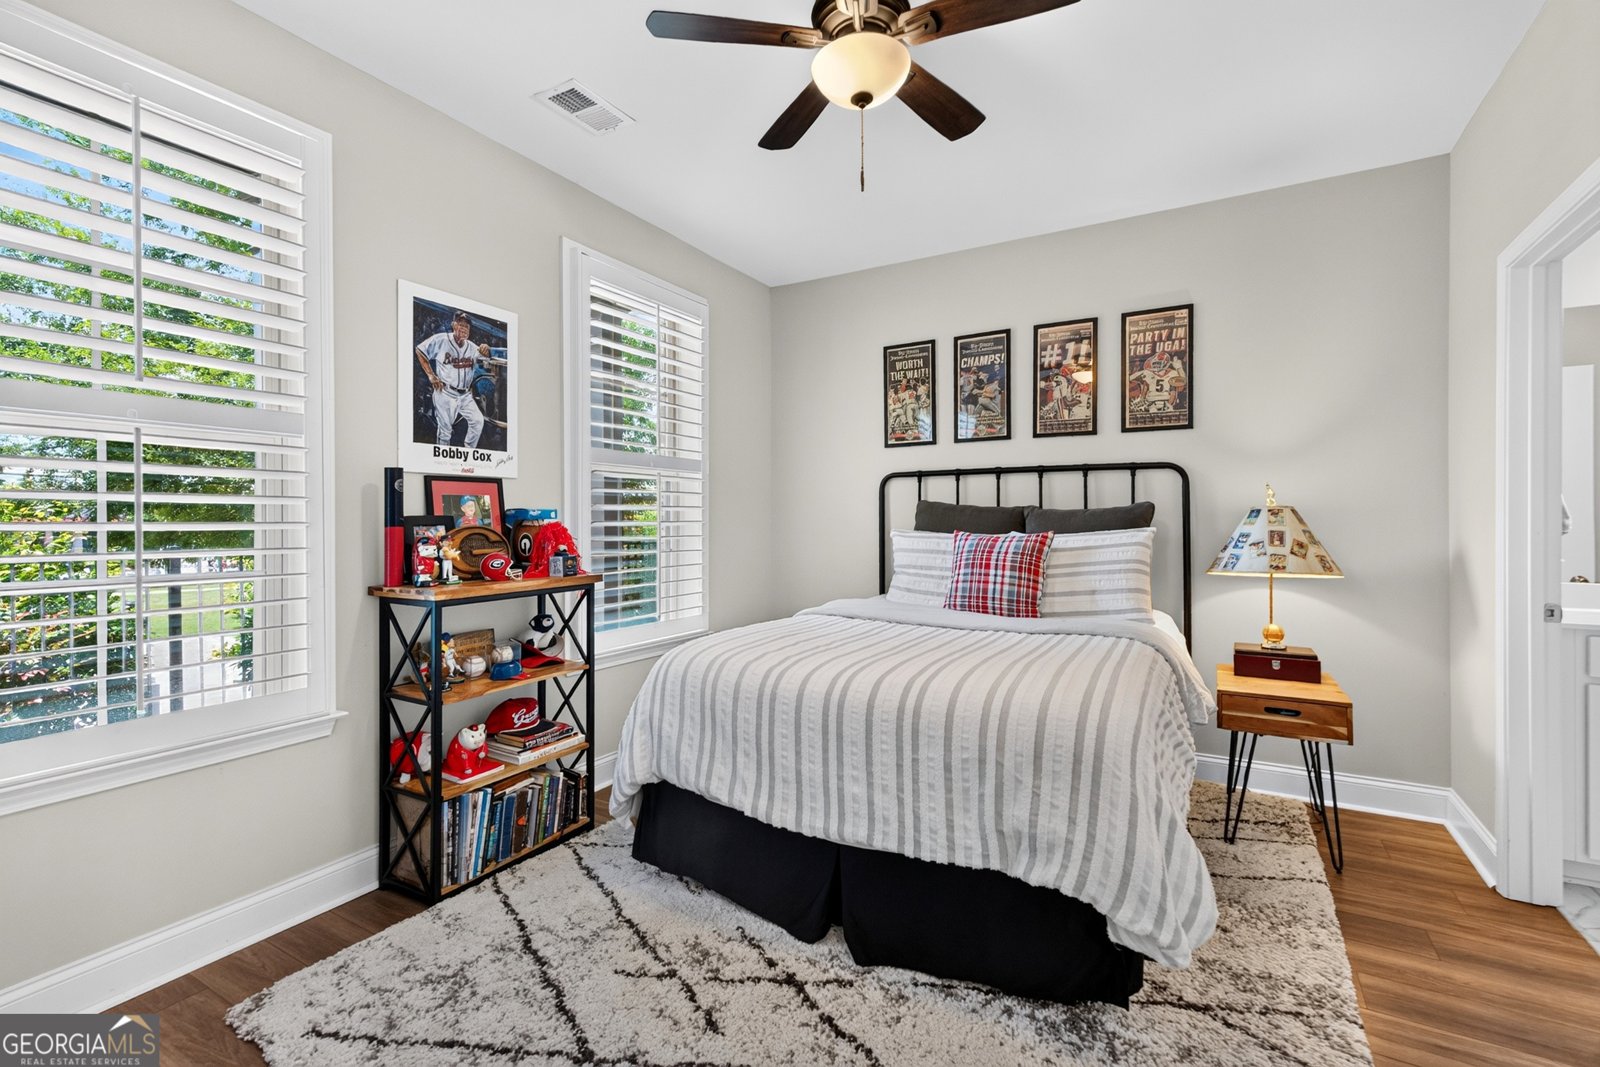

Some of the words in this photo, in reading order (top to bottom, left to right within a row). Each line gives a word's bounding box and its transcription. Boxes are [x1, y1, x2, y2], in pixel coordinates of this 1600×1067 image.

[1130, 328, 1169, 344] PARTY
[1172, 327, 1186, 338] IN
[1129, 343, 1153, 356] THE
[1155, 339, 1187, 353] UGA!
[896, 358, 923, 371] WORTH
[961, 353, 1004, 368] CHAMPS!
[890, 370, 905, 381] THE
[905, 367, 929, 379] WAIT!
[1155, 379, 1164, 393] 5
[433, 445, 469, 462] Bobby
[472, 449, 492, 462] Cox
